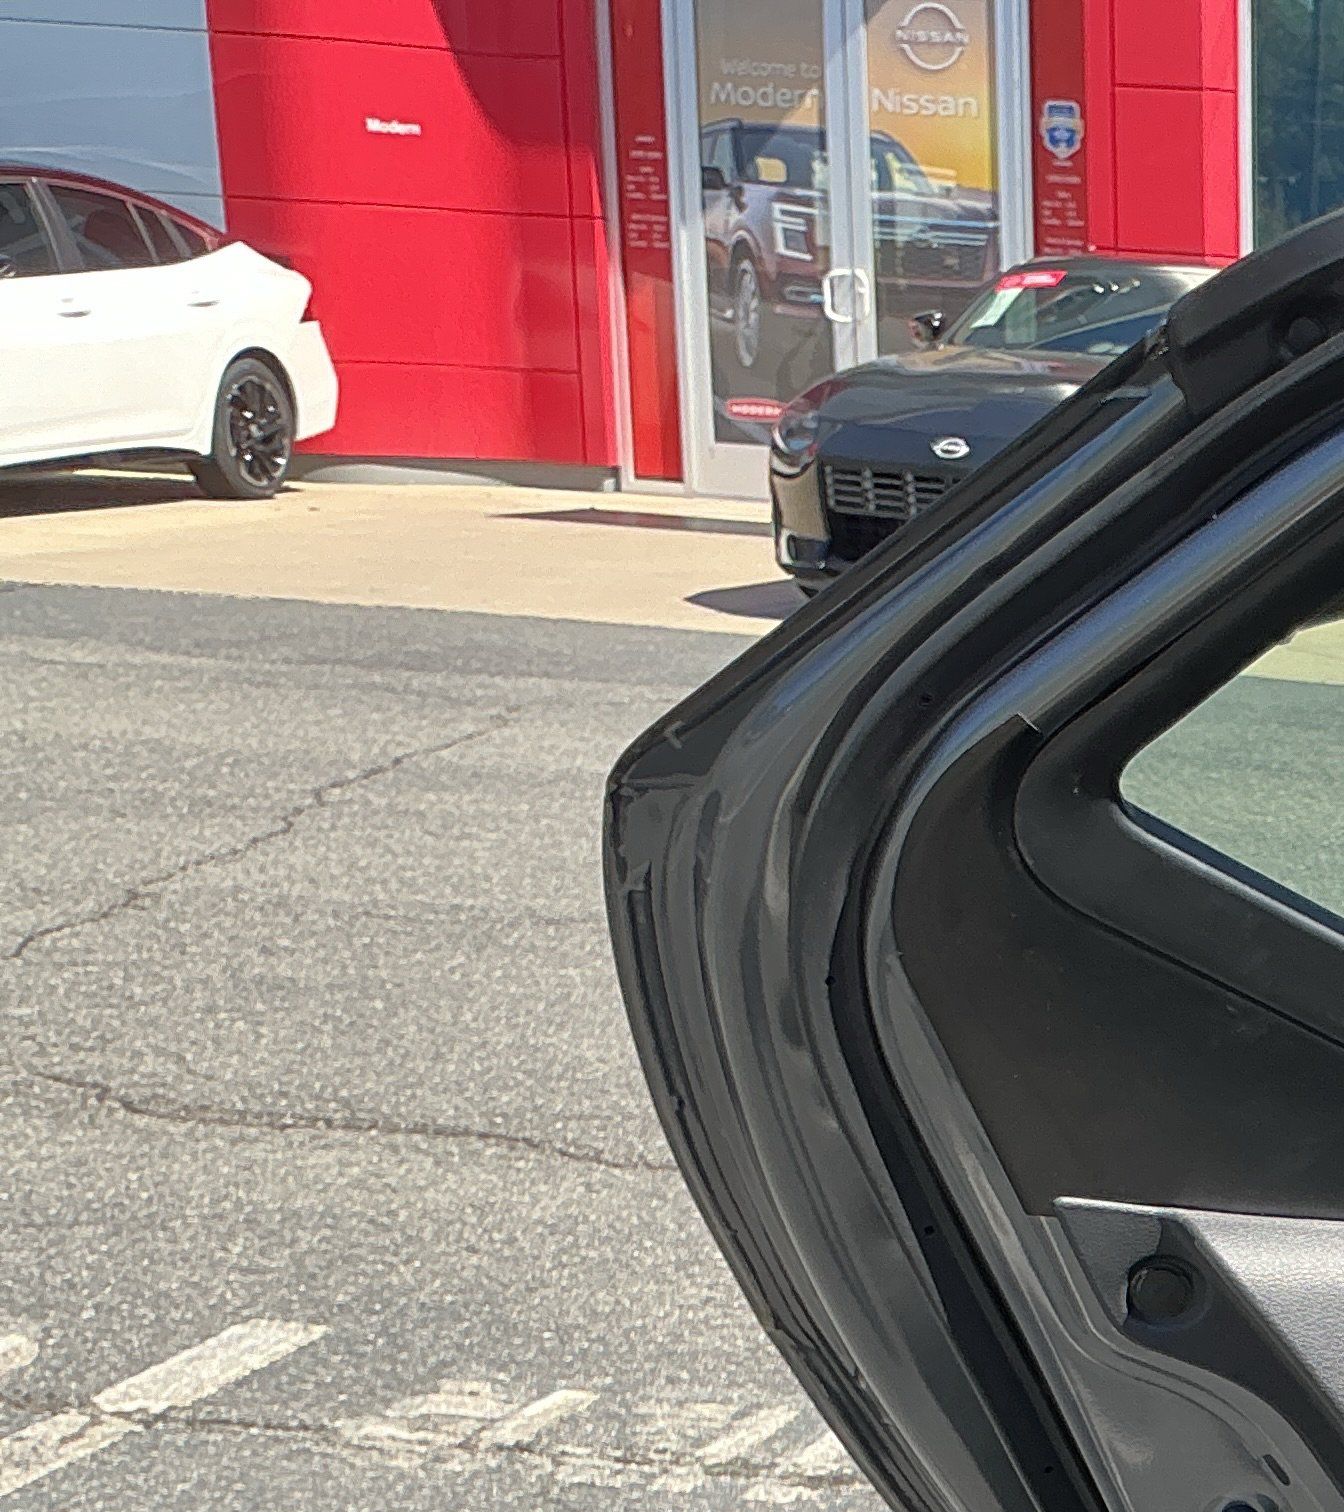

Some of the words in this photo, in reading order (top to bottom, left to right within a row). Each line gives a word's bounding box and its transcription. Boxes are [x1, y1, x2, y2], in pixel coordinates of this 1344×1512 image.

[721, 58, 796, 78] Welcome
[800, 61, 820, 79] to
[871, 87, 978, 117] Nissan
[365, 117, 422, 136] Modern
